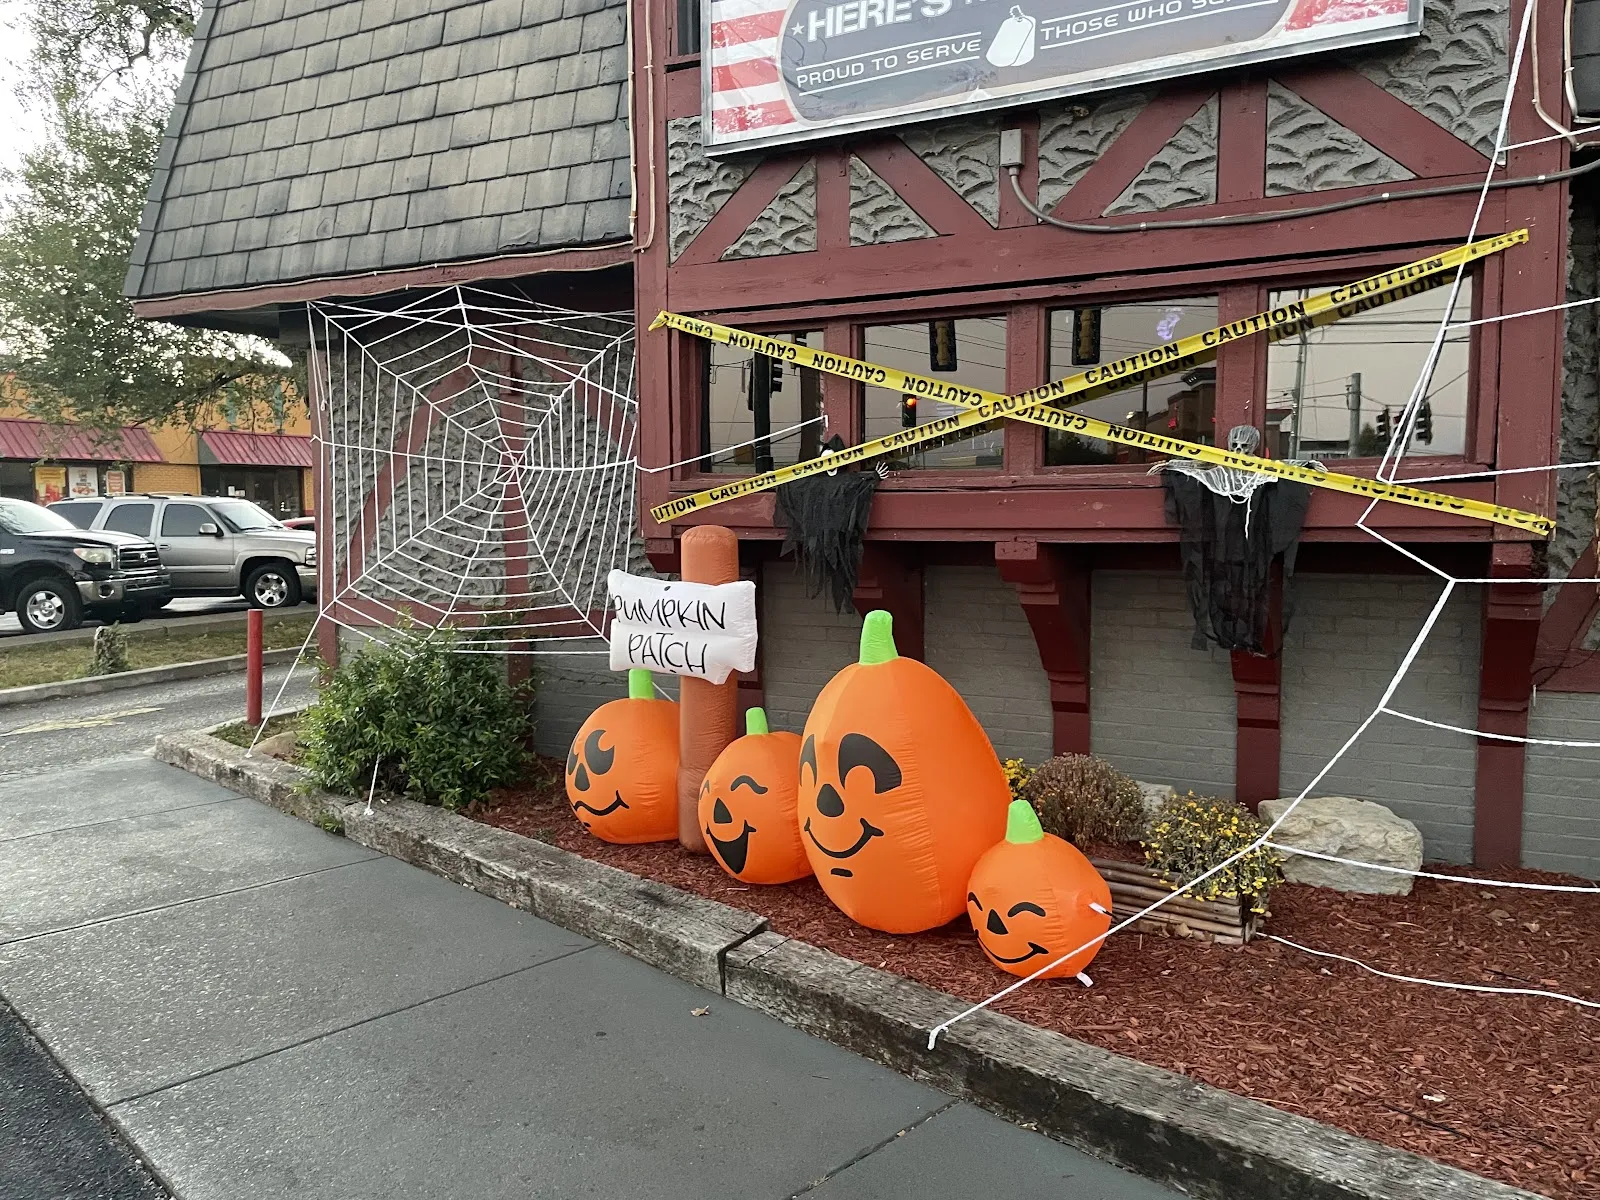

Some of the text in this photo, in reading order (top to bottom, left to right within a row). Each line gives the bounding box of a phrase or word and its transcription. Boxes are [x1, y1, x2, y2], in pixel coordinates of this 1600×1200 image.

[807, 0, 952, 42] HERES
[1040, 14, 1118, 41] THOSE
[1127, 1, 1182, 23] WHO
[797, 39, 981, 88] PROUD TO SERVE
[728, 331, 797, 360] CAUTION
[709, 473, 777, 501] CAUTION
[881, 415, 960, 449] CAUTION
[978, 380, 1065, 418] CAUTION
[1084, 343, 1180, 384] CAUTION
[1201, 301, 1307, 346] CAUTION
[1330, 257, 1444, 304] CAUTION
[812, 353, 887, 383] CAUTION
[902, 375, 983, 407] CAUTION
[1014, 405, 1088, 430] CAUTIO
[614, 594, 726, 631] PUMPKIN
[628, 632, 708, 674] PATCH
